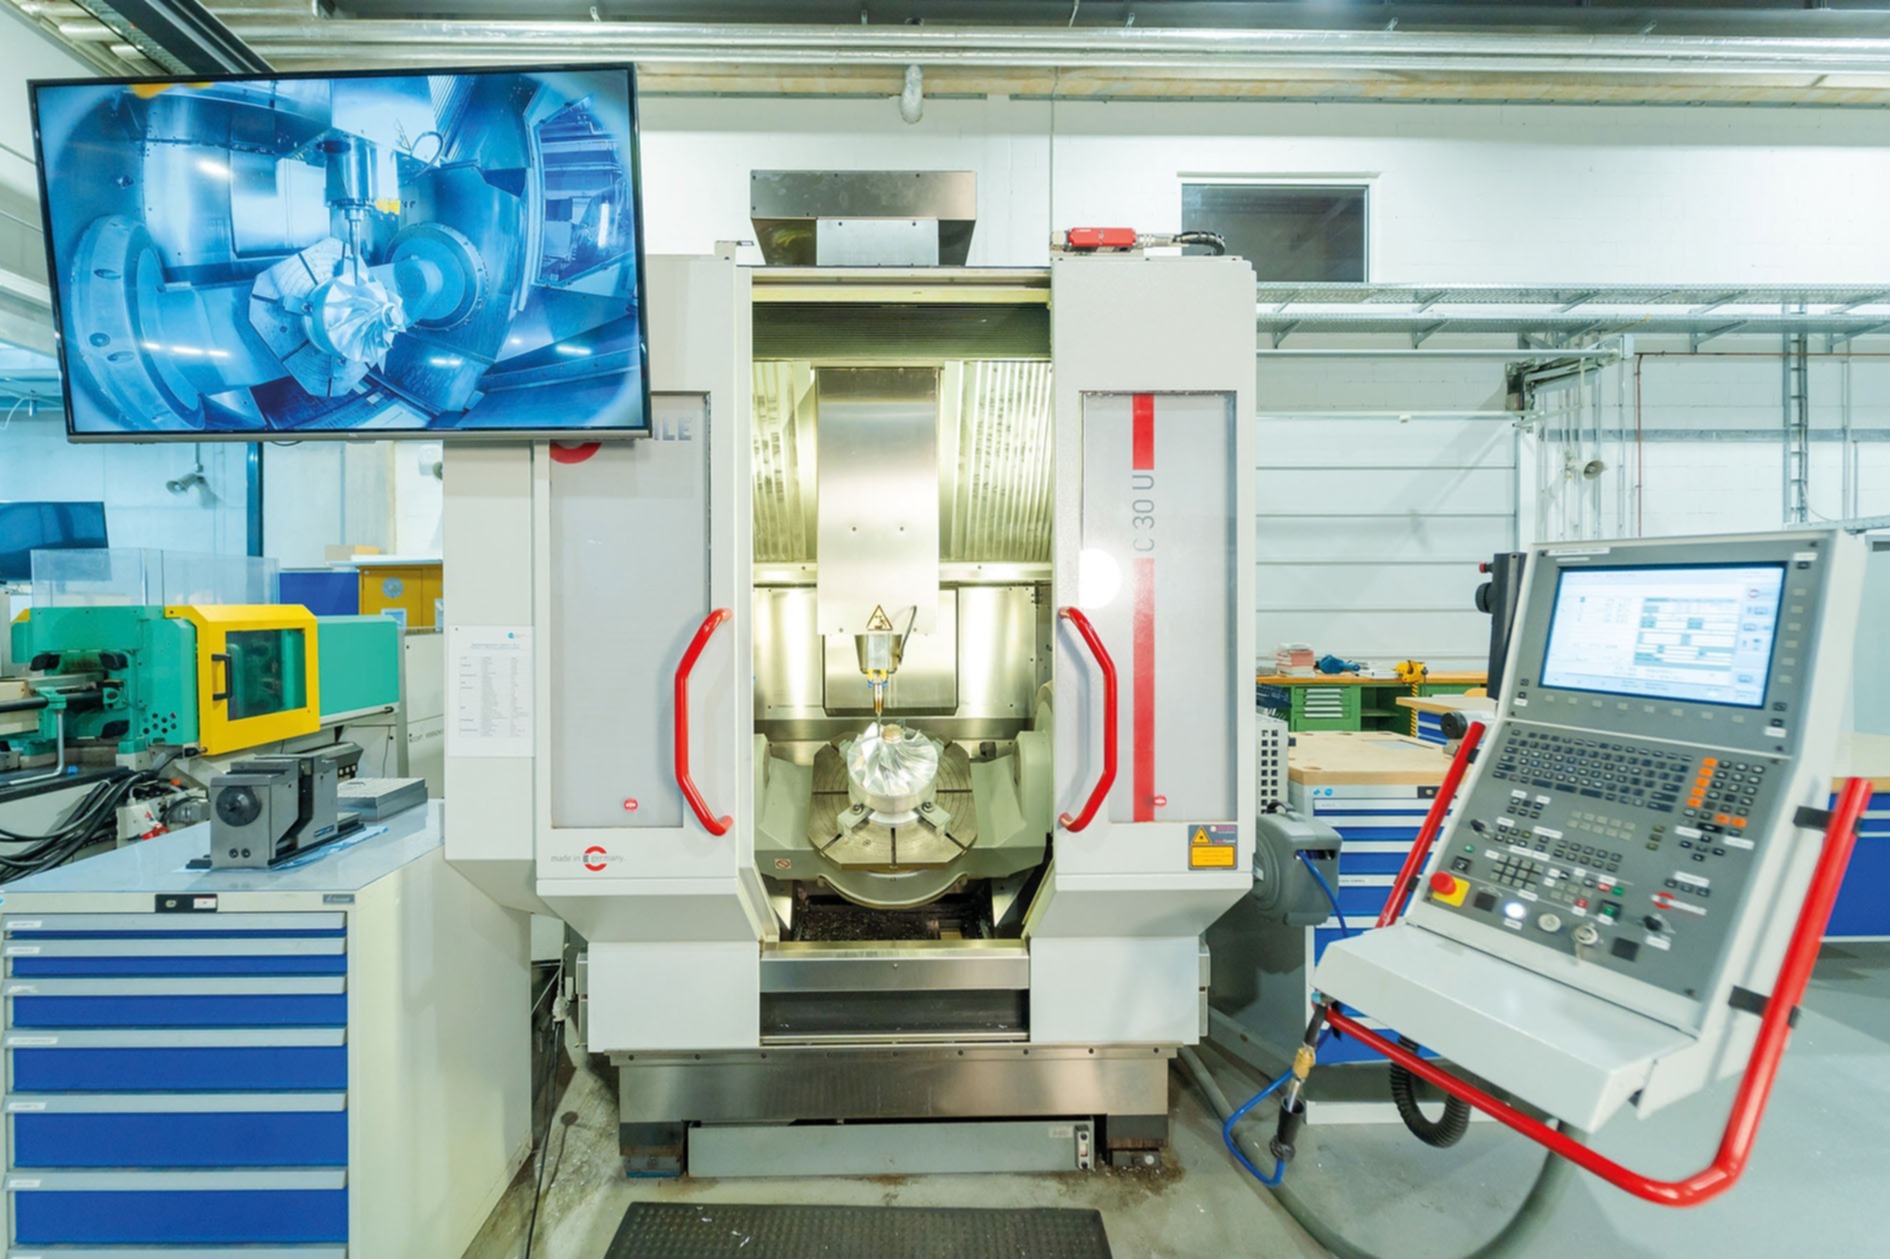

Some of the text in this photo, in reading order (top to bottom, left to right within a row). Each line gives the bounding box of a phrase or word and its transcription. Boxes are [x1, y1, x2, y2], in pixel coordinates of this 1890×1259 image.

[654, 416, 692, 441] LE
[1132, 474, 1155, 552] C 30 U
[551, 854, 572, 862] made
